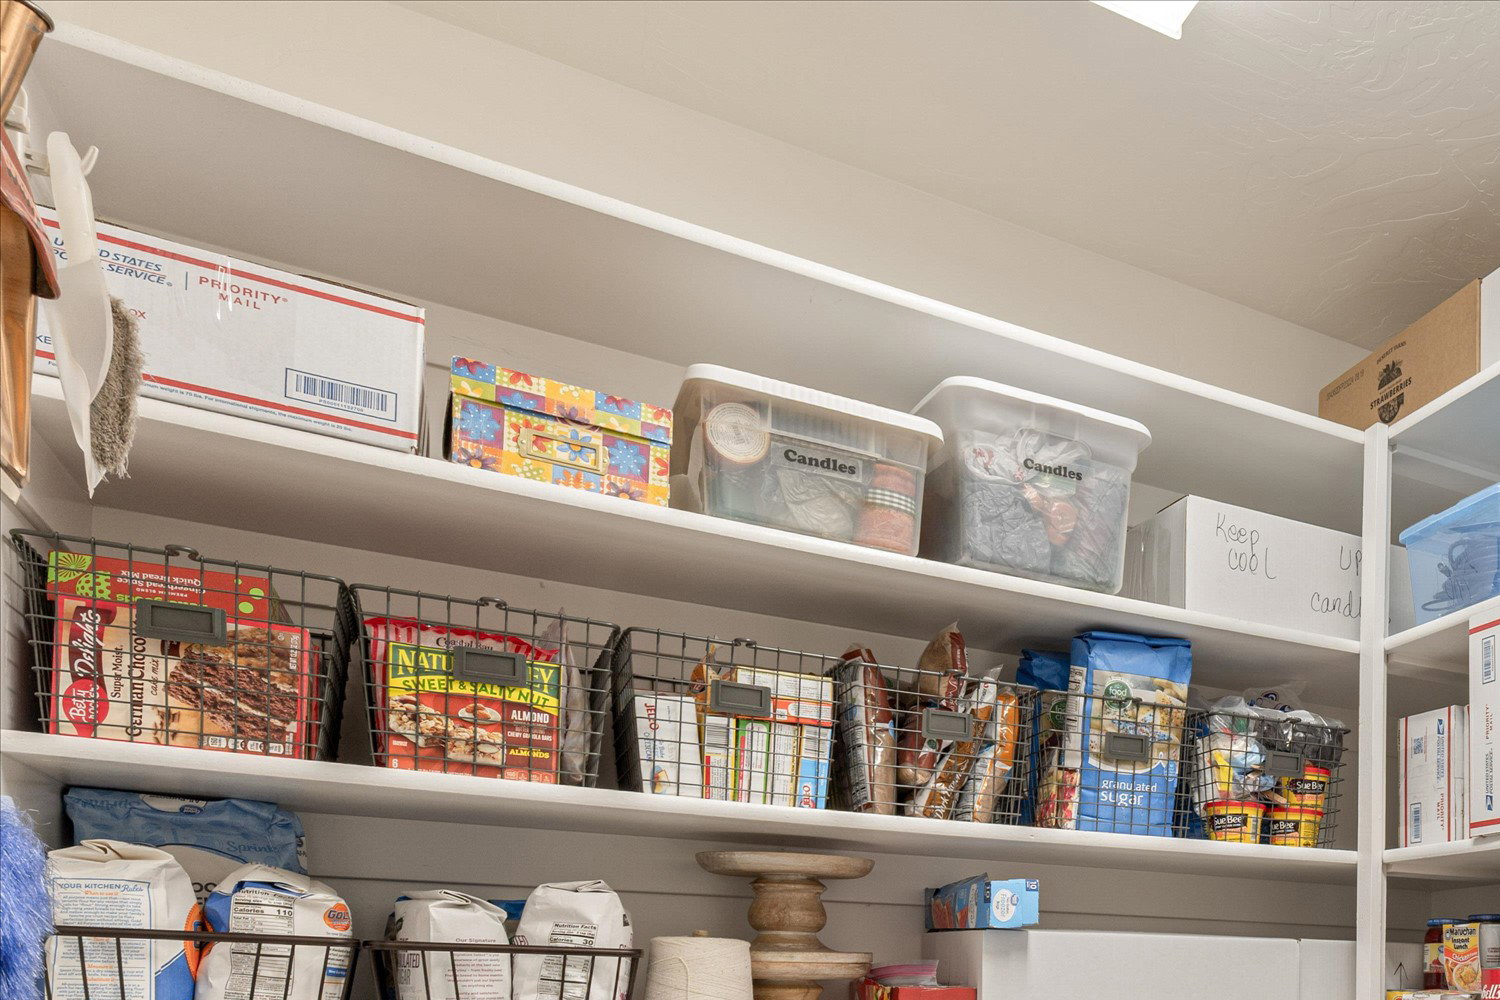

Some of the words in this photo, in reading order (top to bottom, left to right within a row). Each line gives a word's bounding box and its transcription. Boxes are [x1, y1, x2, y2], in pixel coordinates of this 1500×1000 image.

[107, 264, 165, 286] SERVICE
[111, 252, 163, 273] STATES
[199, 275, 282, 305] PRIORITY
[218, 292, 261, 311] MAIL
[1370, 376, 1413, 411] STRAWBERRIES
[783, 448, 858, 477] Candles
[1022, 457, 1085, 483] Candles
[1215, 512, 1260, 552] Keep
[74, 608, 101, 676] Delights
[397, 648, 454, 676] NATU
[402, 678, 454, 692] SWEET
[458, 681, 467, 691] &
[470, 681, 516, 699] SALTY
[518, 690, 549, 708] NUT
[511, 709, 550, 724] ALMOND
[84, 883, 121, 891] KITCHEN
[234, 906, 264, 915] Calories
[1450, 926, 1477, 936] Maruchan
